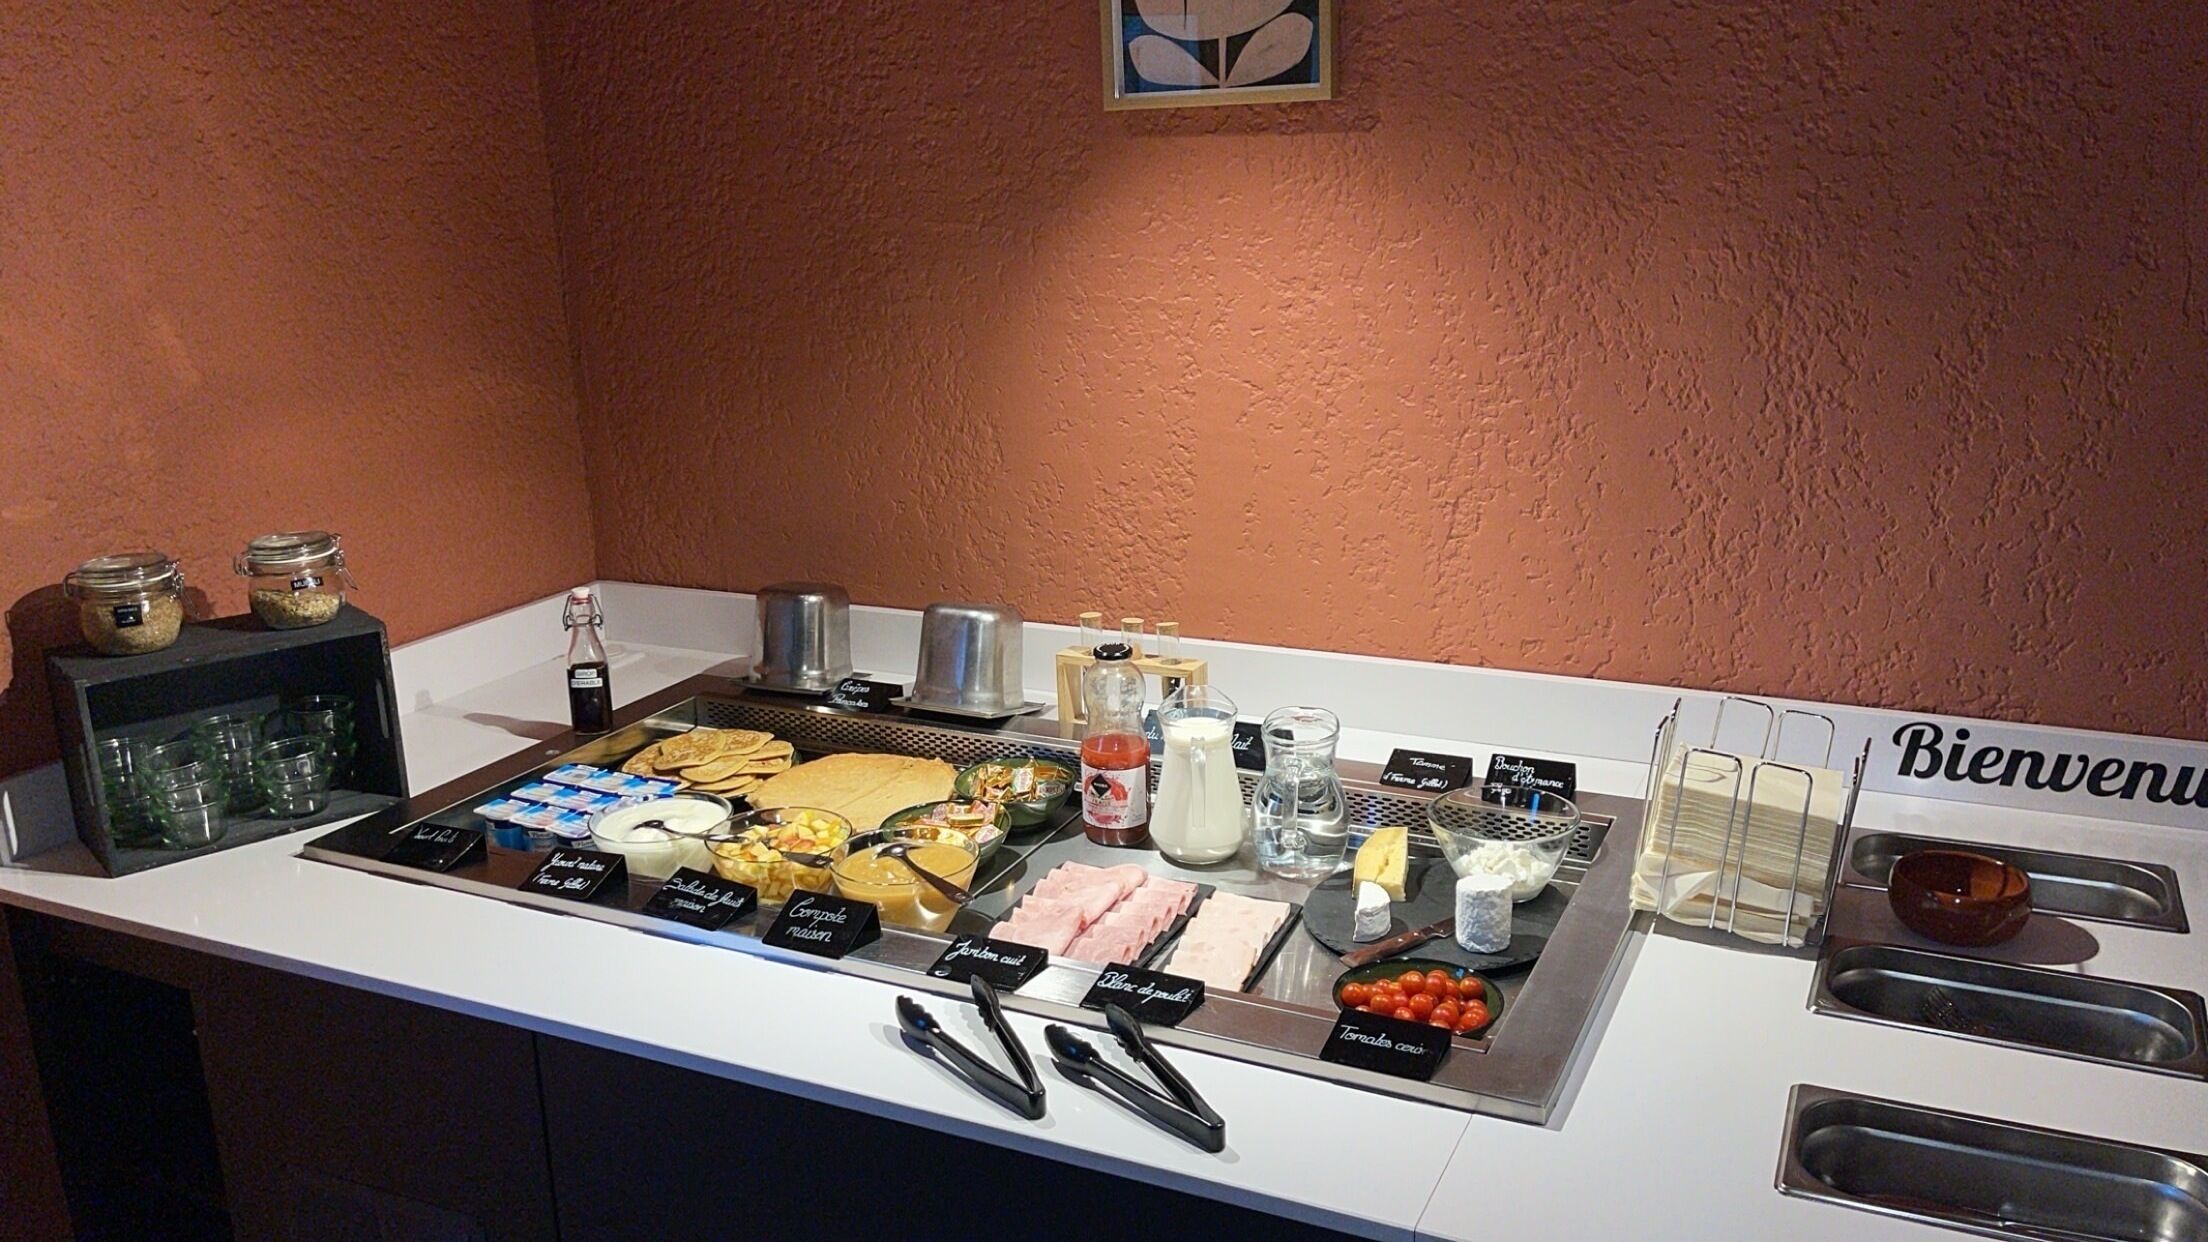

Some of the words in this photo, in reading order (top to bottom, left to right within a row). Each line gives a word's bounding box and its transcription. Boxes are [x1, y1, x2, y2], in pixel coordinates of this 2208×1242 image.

[789, 896, 848, 929] Compote
[785, 924, 832, 943] maison
[944, 939, 999, 962] Jambon
[999, 954, 1027, 966] cuit
[1096, 971, 1138, 993] Blanc
[1136, 982, 1156, 996] de
[1339, 1024, 1393, 1049] Tomates
